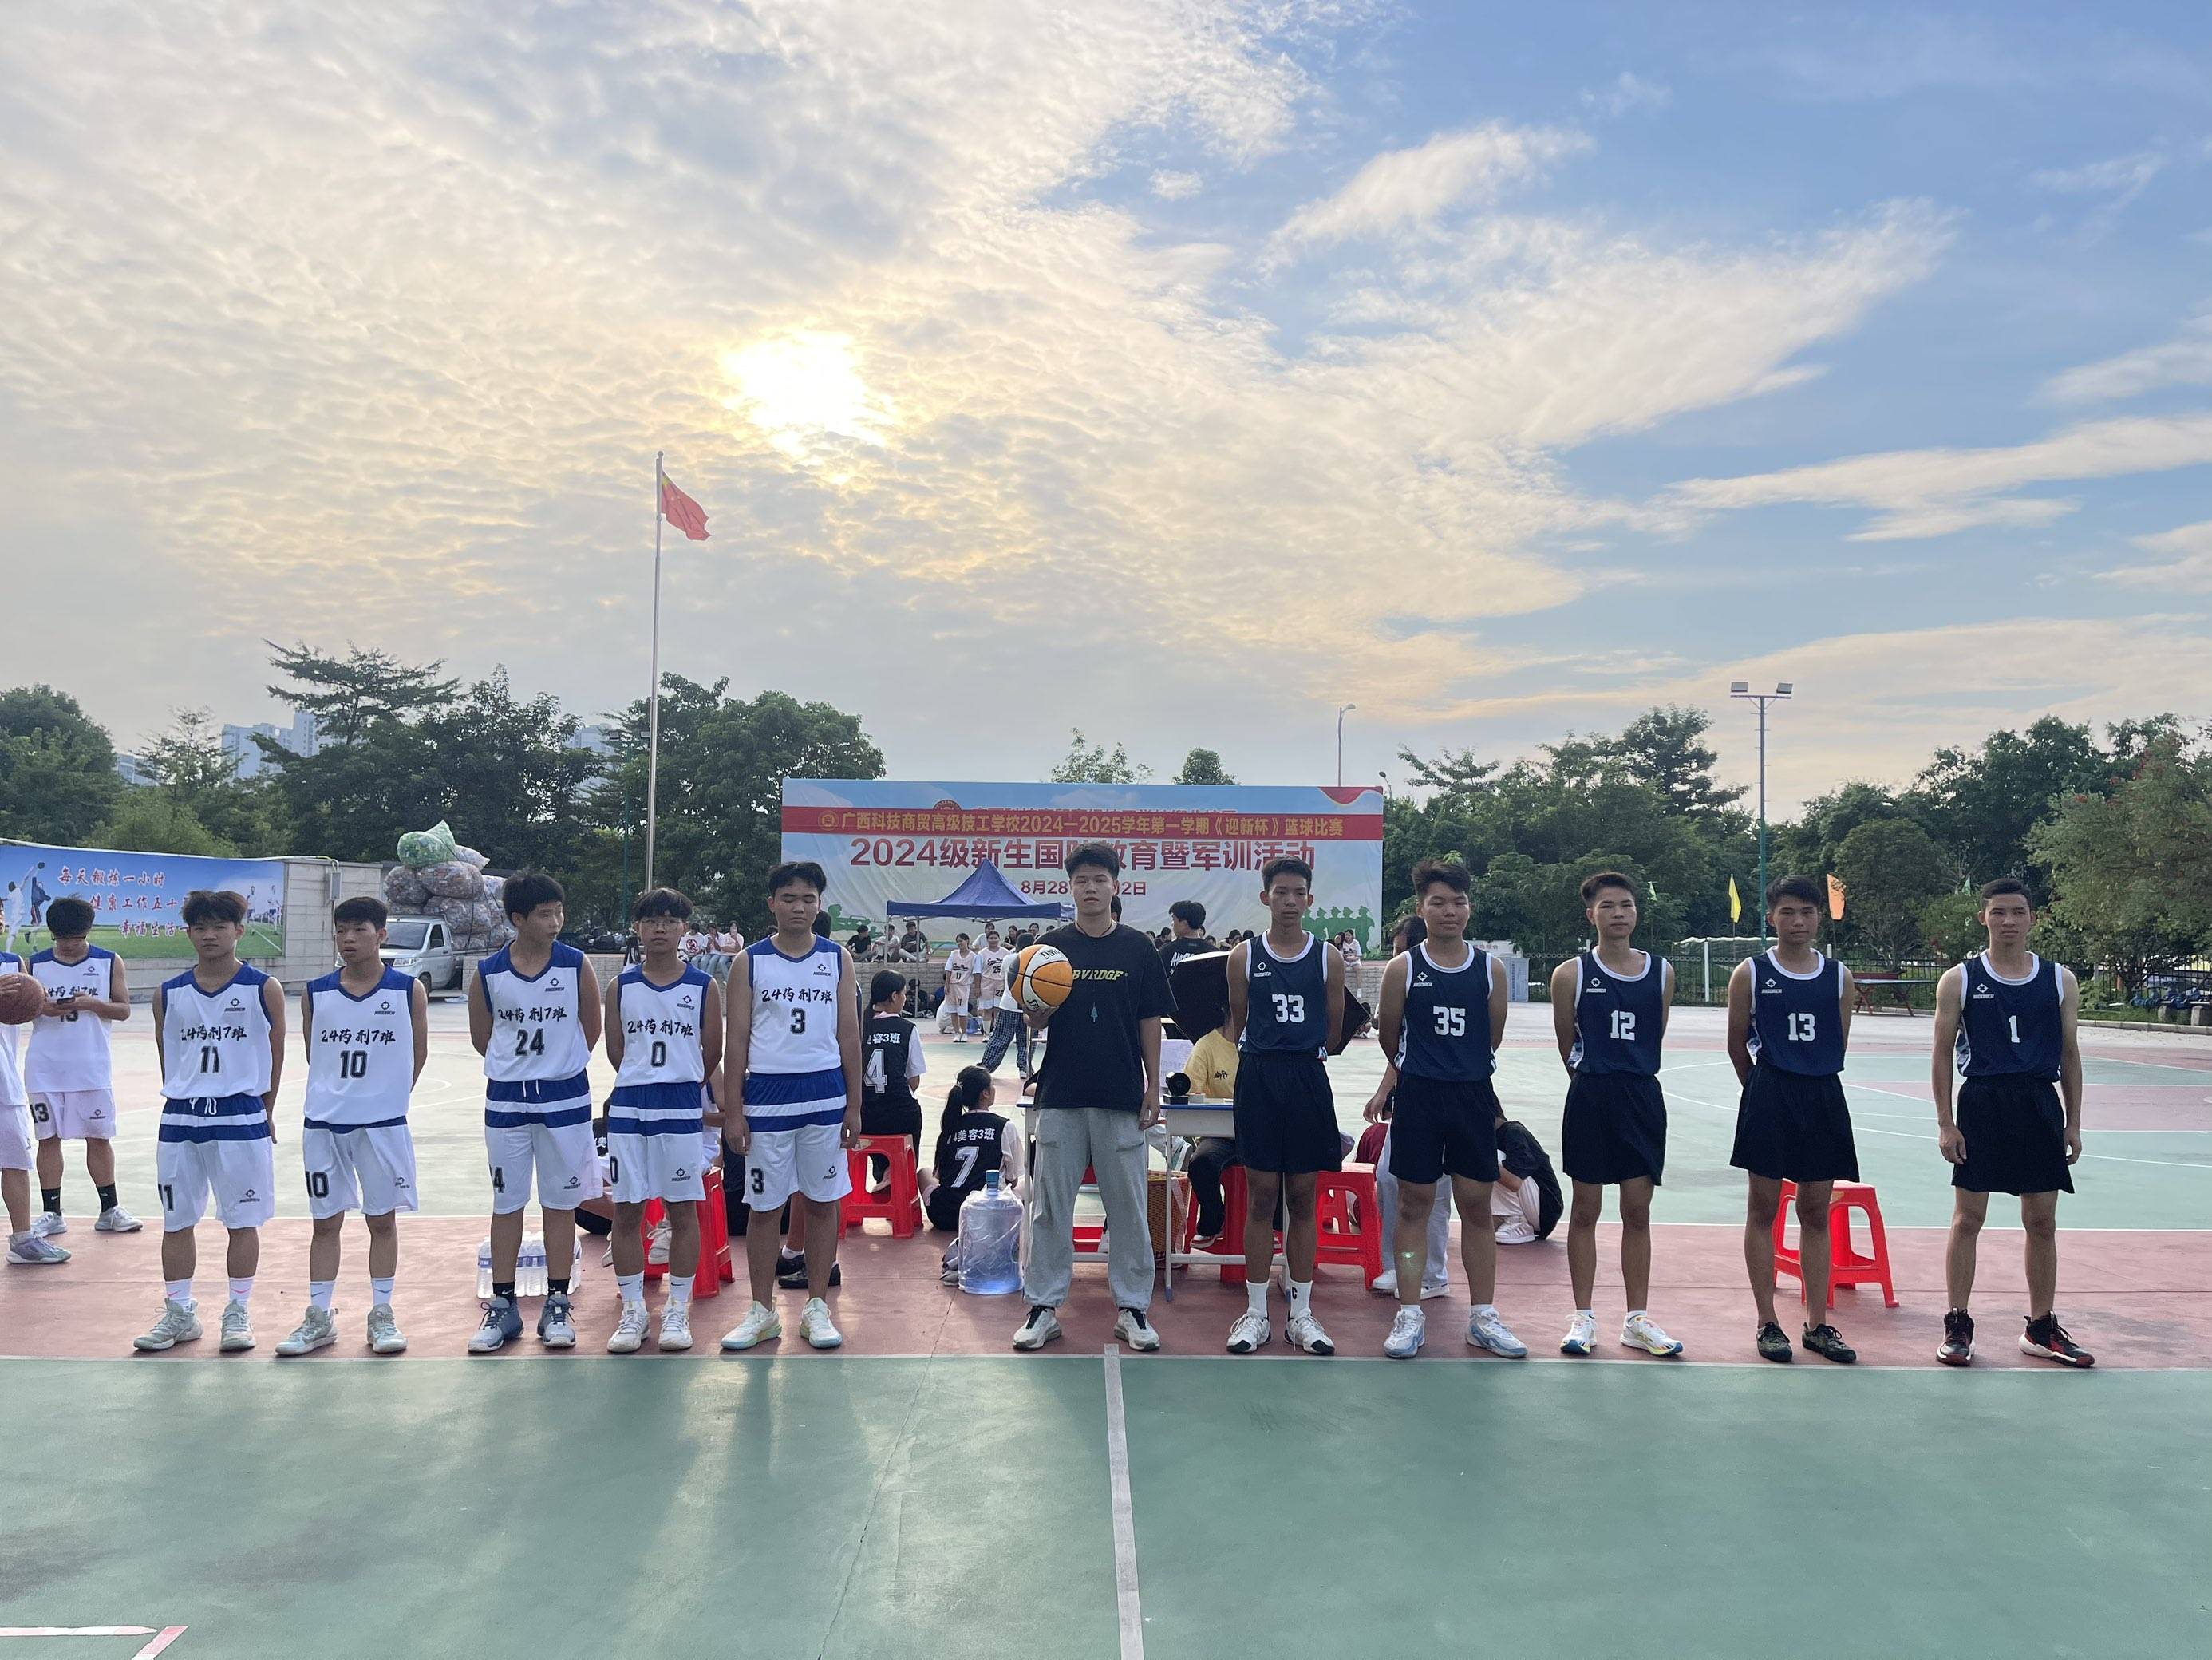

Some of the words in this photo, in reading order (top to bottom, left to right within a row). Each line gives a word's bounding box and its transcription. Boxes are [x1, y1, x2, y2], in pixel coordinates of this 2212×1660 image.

[850, 837, 1315, 872] 2024级新生国育暨军训活动
[89, 893, 188, 912] 健康工作五十
[48, 986, 98, 997] 4药剂7班
[761, 986, 832, 1005] 24药剂7班
[790, 1007, 806, 1035] 3
[1272, 994, 1305, 1023] 33
[1432, 1006, 1466, 1037] 35
[321, 1027, 396, 1045] 24药剂7班
[1610, 1010, 1636, 1041] 12
[1787, 1013, 1815, 1041] 13
[2009, 1015, 2020, 1043] 1
[515, 1028, 545, 1057] 24
[650, 1041, 666, 1068] 0
[200, 1045, 220, 1074] 11
[340, 1050, 368, 1079] 10
[863, 1049, 888, 1094] 4
[489, 1165, 506, 1194] 4
[951, 1146, 980, 1188] 7
[305, 1171, 329, 1199] 10
[750, 1168, 764, 1195] 3
